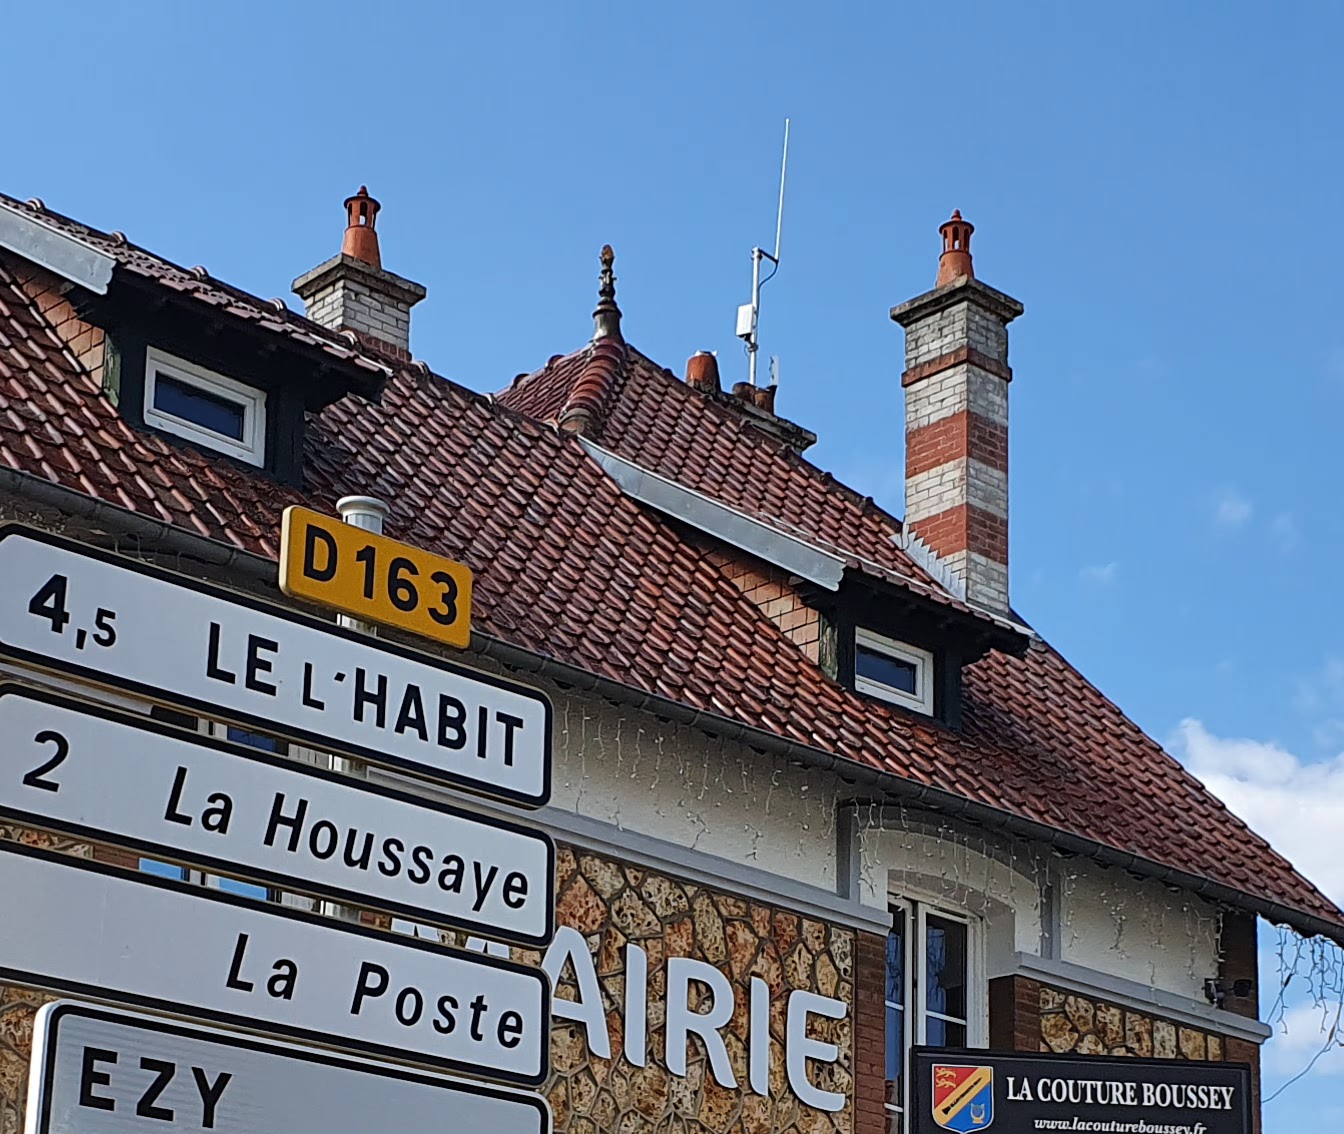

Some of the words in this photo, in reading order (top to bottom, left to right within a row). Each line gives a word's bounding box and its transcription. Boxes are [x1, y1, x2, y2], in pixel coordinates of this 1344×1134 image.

[28, 574, 117, 650] 4,5
[205, 622, 279, 697] LE
[21, 730, 70, 793] 2
[162, 765, 233, 835] La
[262, 792, 529, 913] Houssaye
[224, 932, 298, 1001] La
[349, 961, 524, 1049] Poste
[78, 1045, 233, 1129] EZY
[1006, 1076, 1034, 1101] LA
[1037, 1078, 1138, 1106] COUTURE
[1141, 1082, 1235, 1110] BOUSSEY
